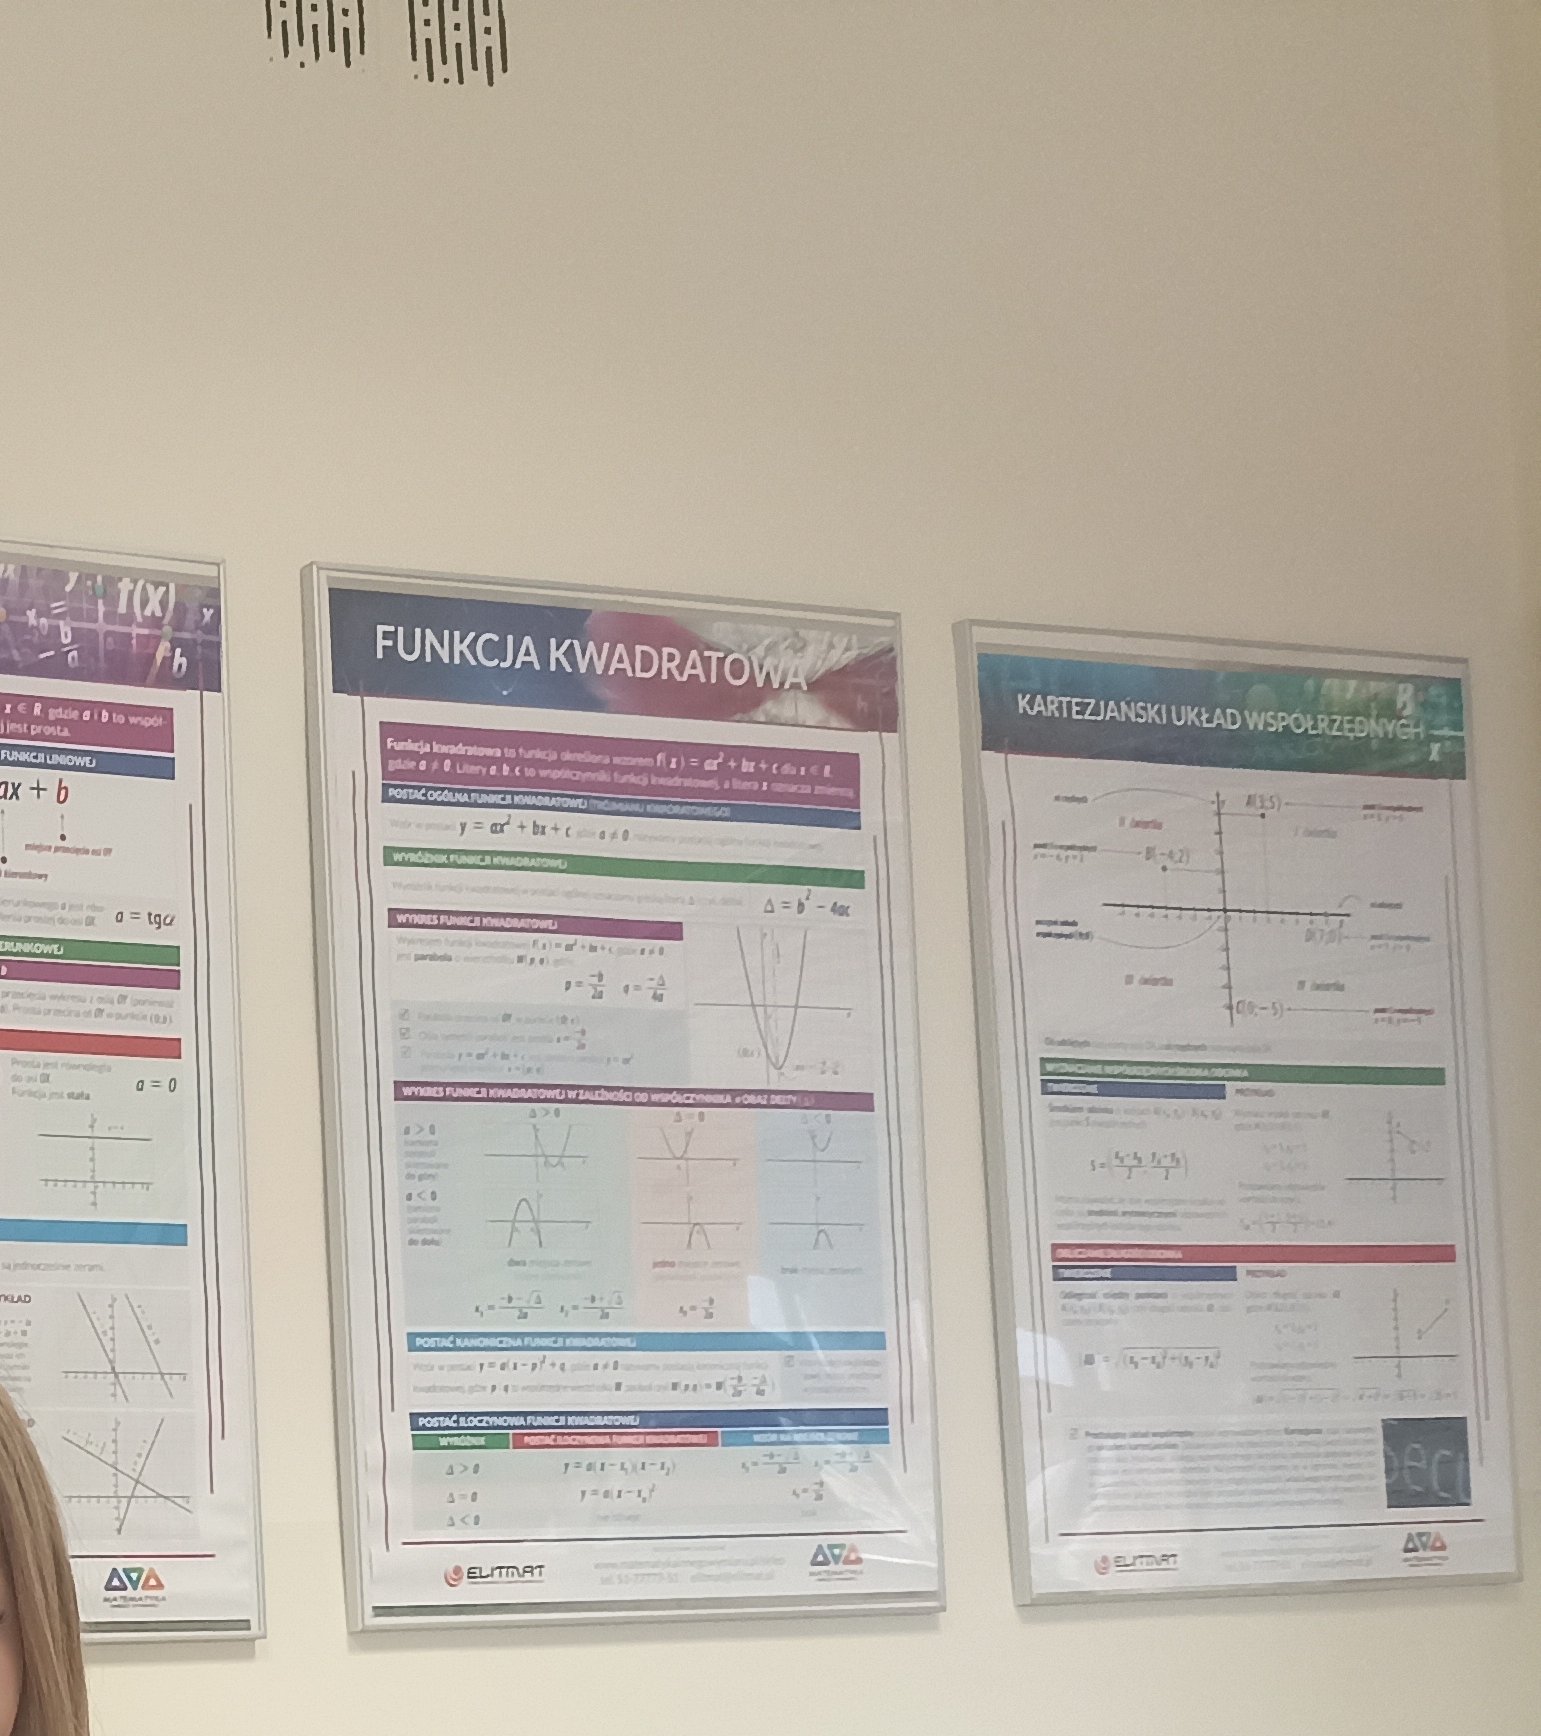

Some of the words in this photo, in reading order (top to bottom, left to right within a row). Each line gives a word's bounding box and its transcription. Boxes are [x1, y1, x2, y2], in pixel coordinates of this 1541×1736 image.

[376, 624, 541, 671] FUNKCJA
[549, 637, 807, 690] KWADRATOWA
[1017, 693, 1167, 725] KARTEZJAŃSKI
[1171, 705, 1242, 730] UKŁAD
[1244, 710, 1424, 740] WSPÓŁRZĘDNYCH
[467, 1564, 545, 1579] ELITMAT
